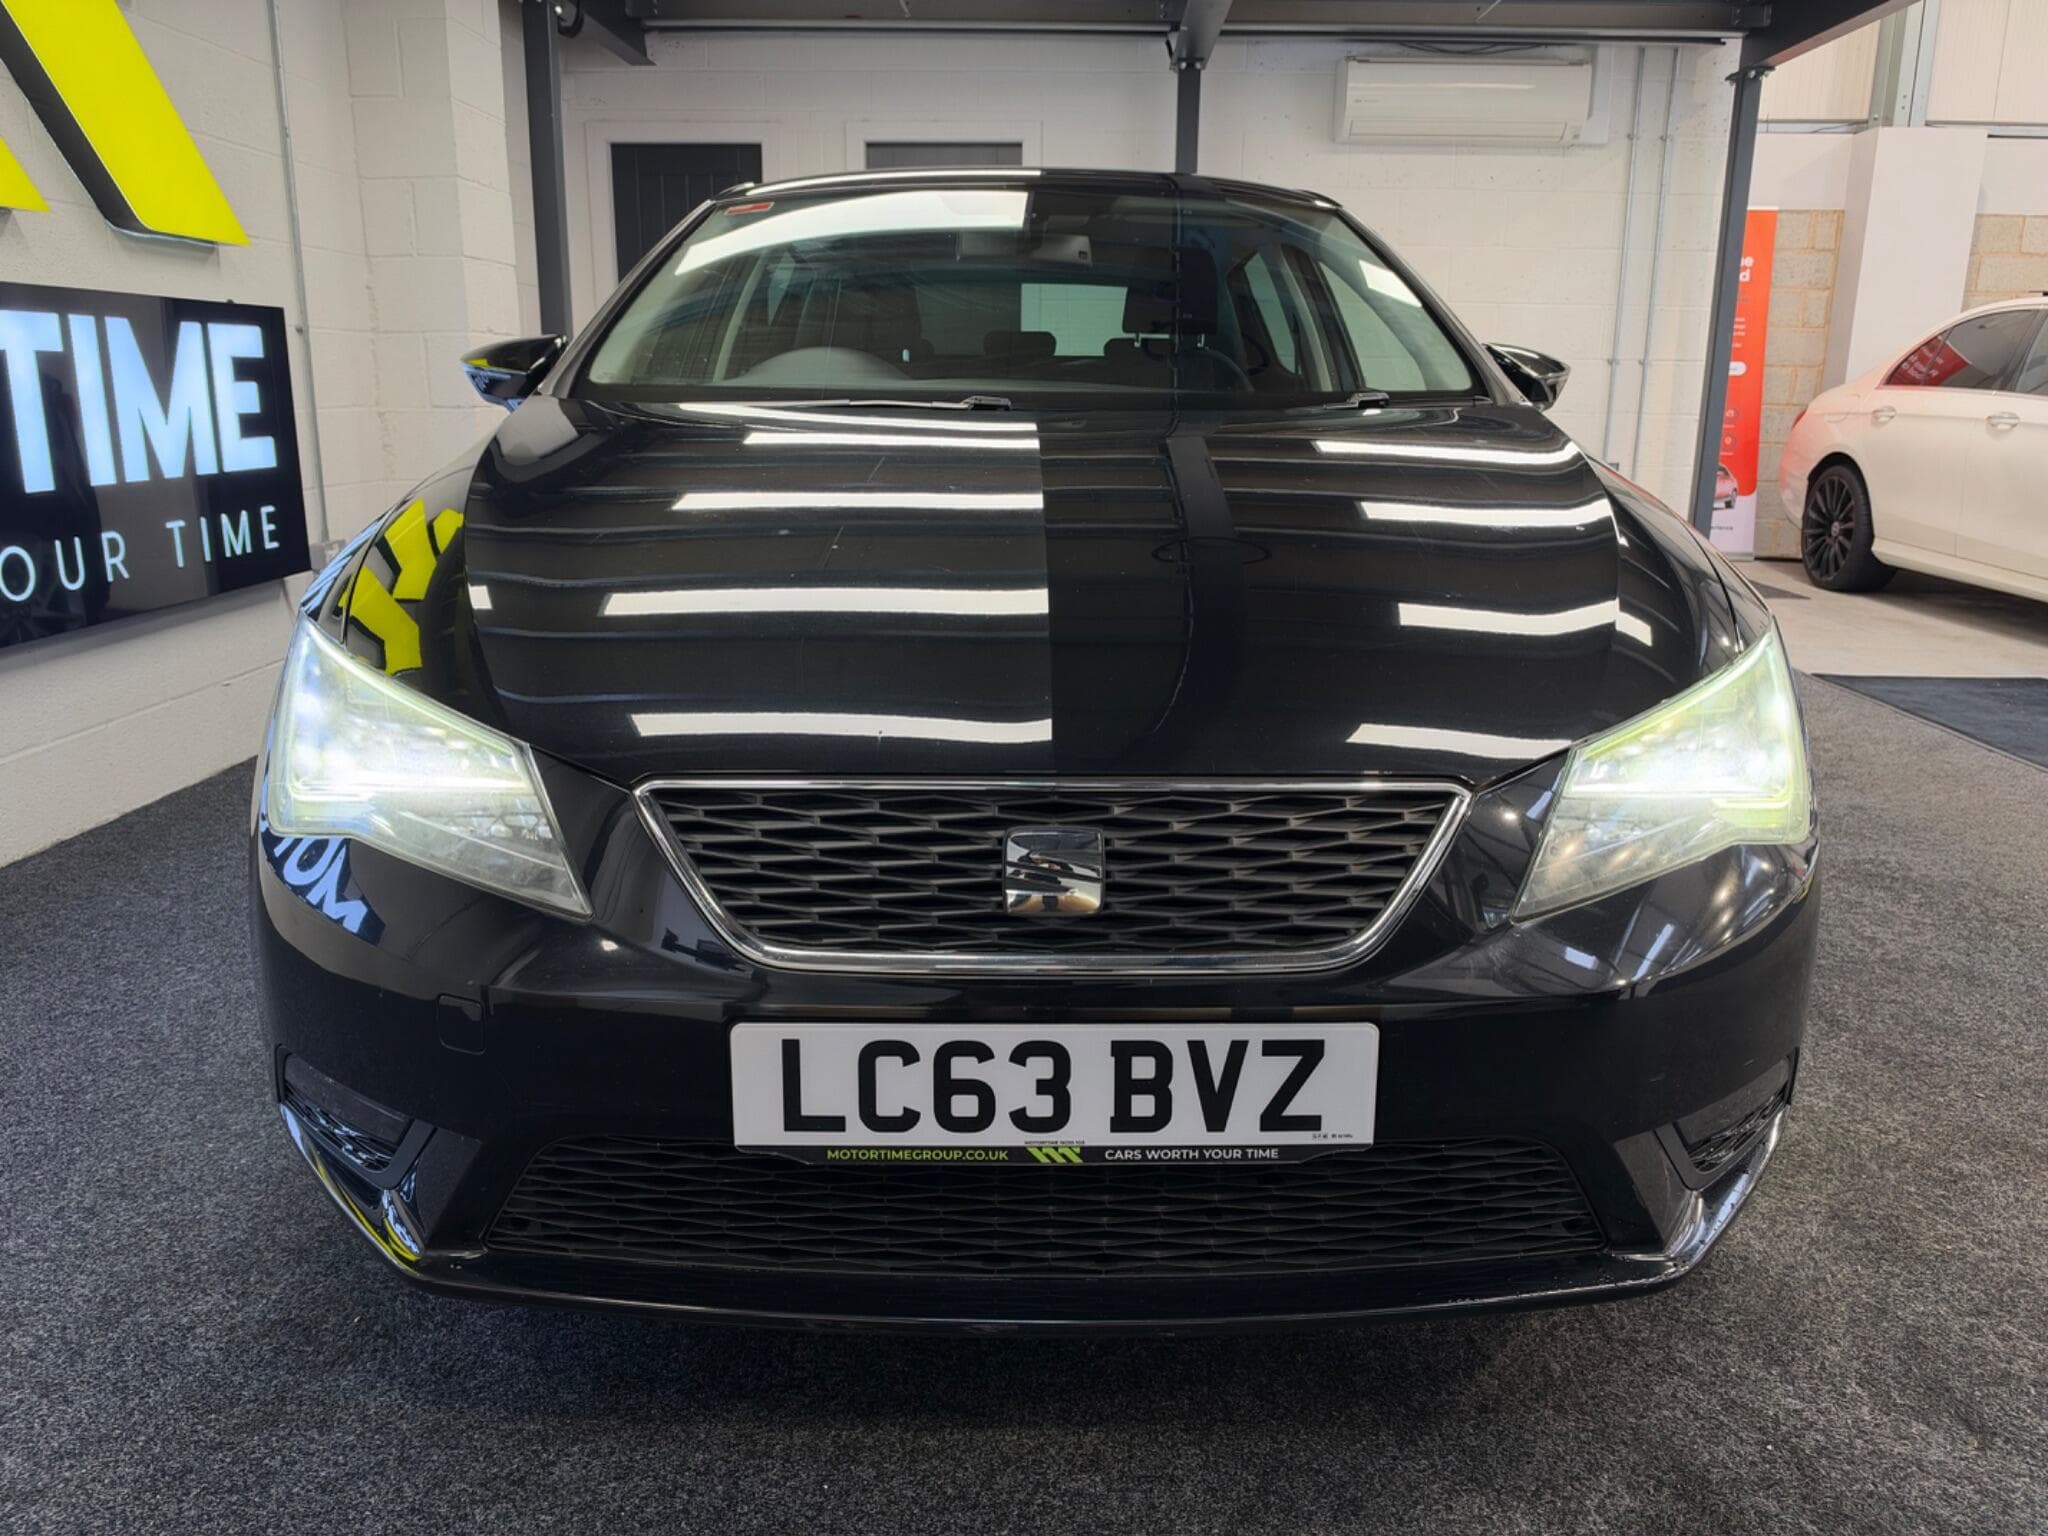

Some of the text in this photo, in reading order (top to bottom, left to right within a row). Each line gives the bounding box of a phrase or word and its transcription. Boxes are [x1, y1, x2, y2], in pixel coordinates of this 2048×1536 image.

[0, 309, 278, 494] TIME
[165, 505, 281, 568] TIME
[781, 1038, 1325, 1133] LC63 BVZ
[826, 1149, 1009, 1161] MOTORTIMEGROUP.CO.UK
[1104, 1148, 1279, 1160] CARS WORTH YOUR TIME
